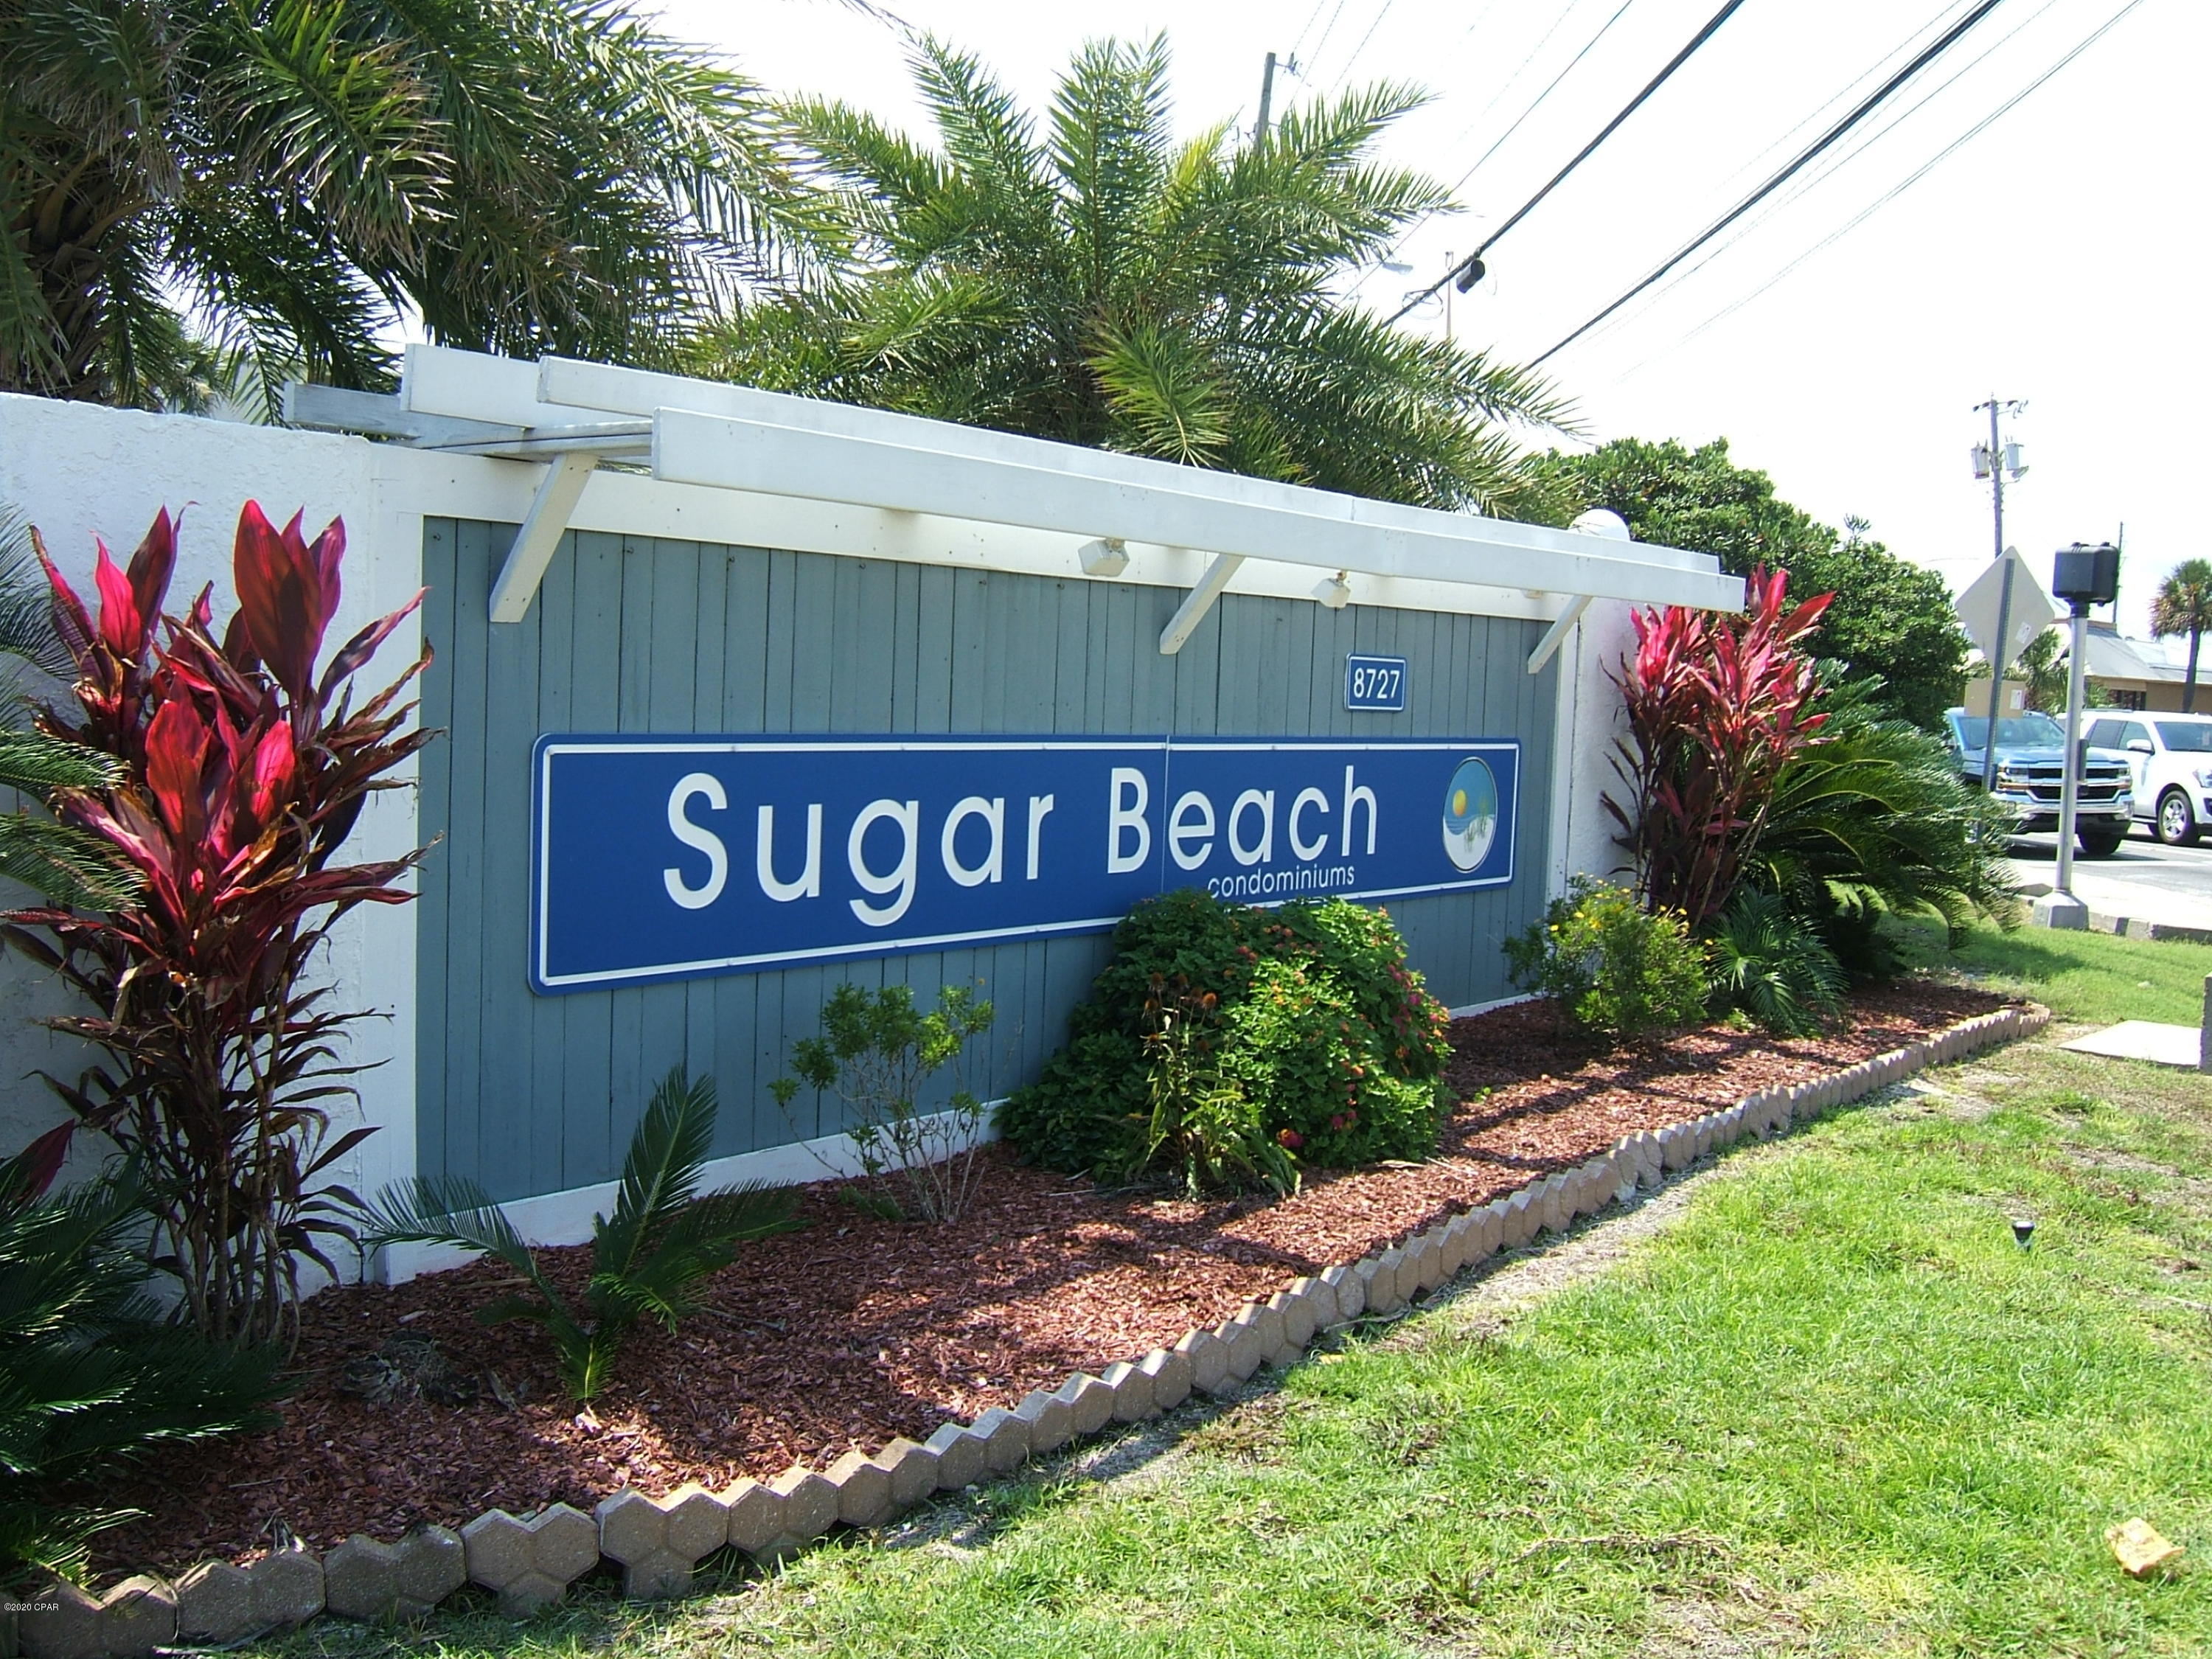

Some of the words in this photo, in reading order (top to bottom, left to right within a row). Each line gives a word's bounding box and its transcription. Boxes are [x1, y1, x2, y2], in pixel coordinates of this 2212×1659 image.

[1354, 667, 1400, 699] 8727
[664, 772, 1054, 927] Sugar
[1107, 765, 1376, 874] Beach
[1208, 863, 1354, 899] condominiums
